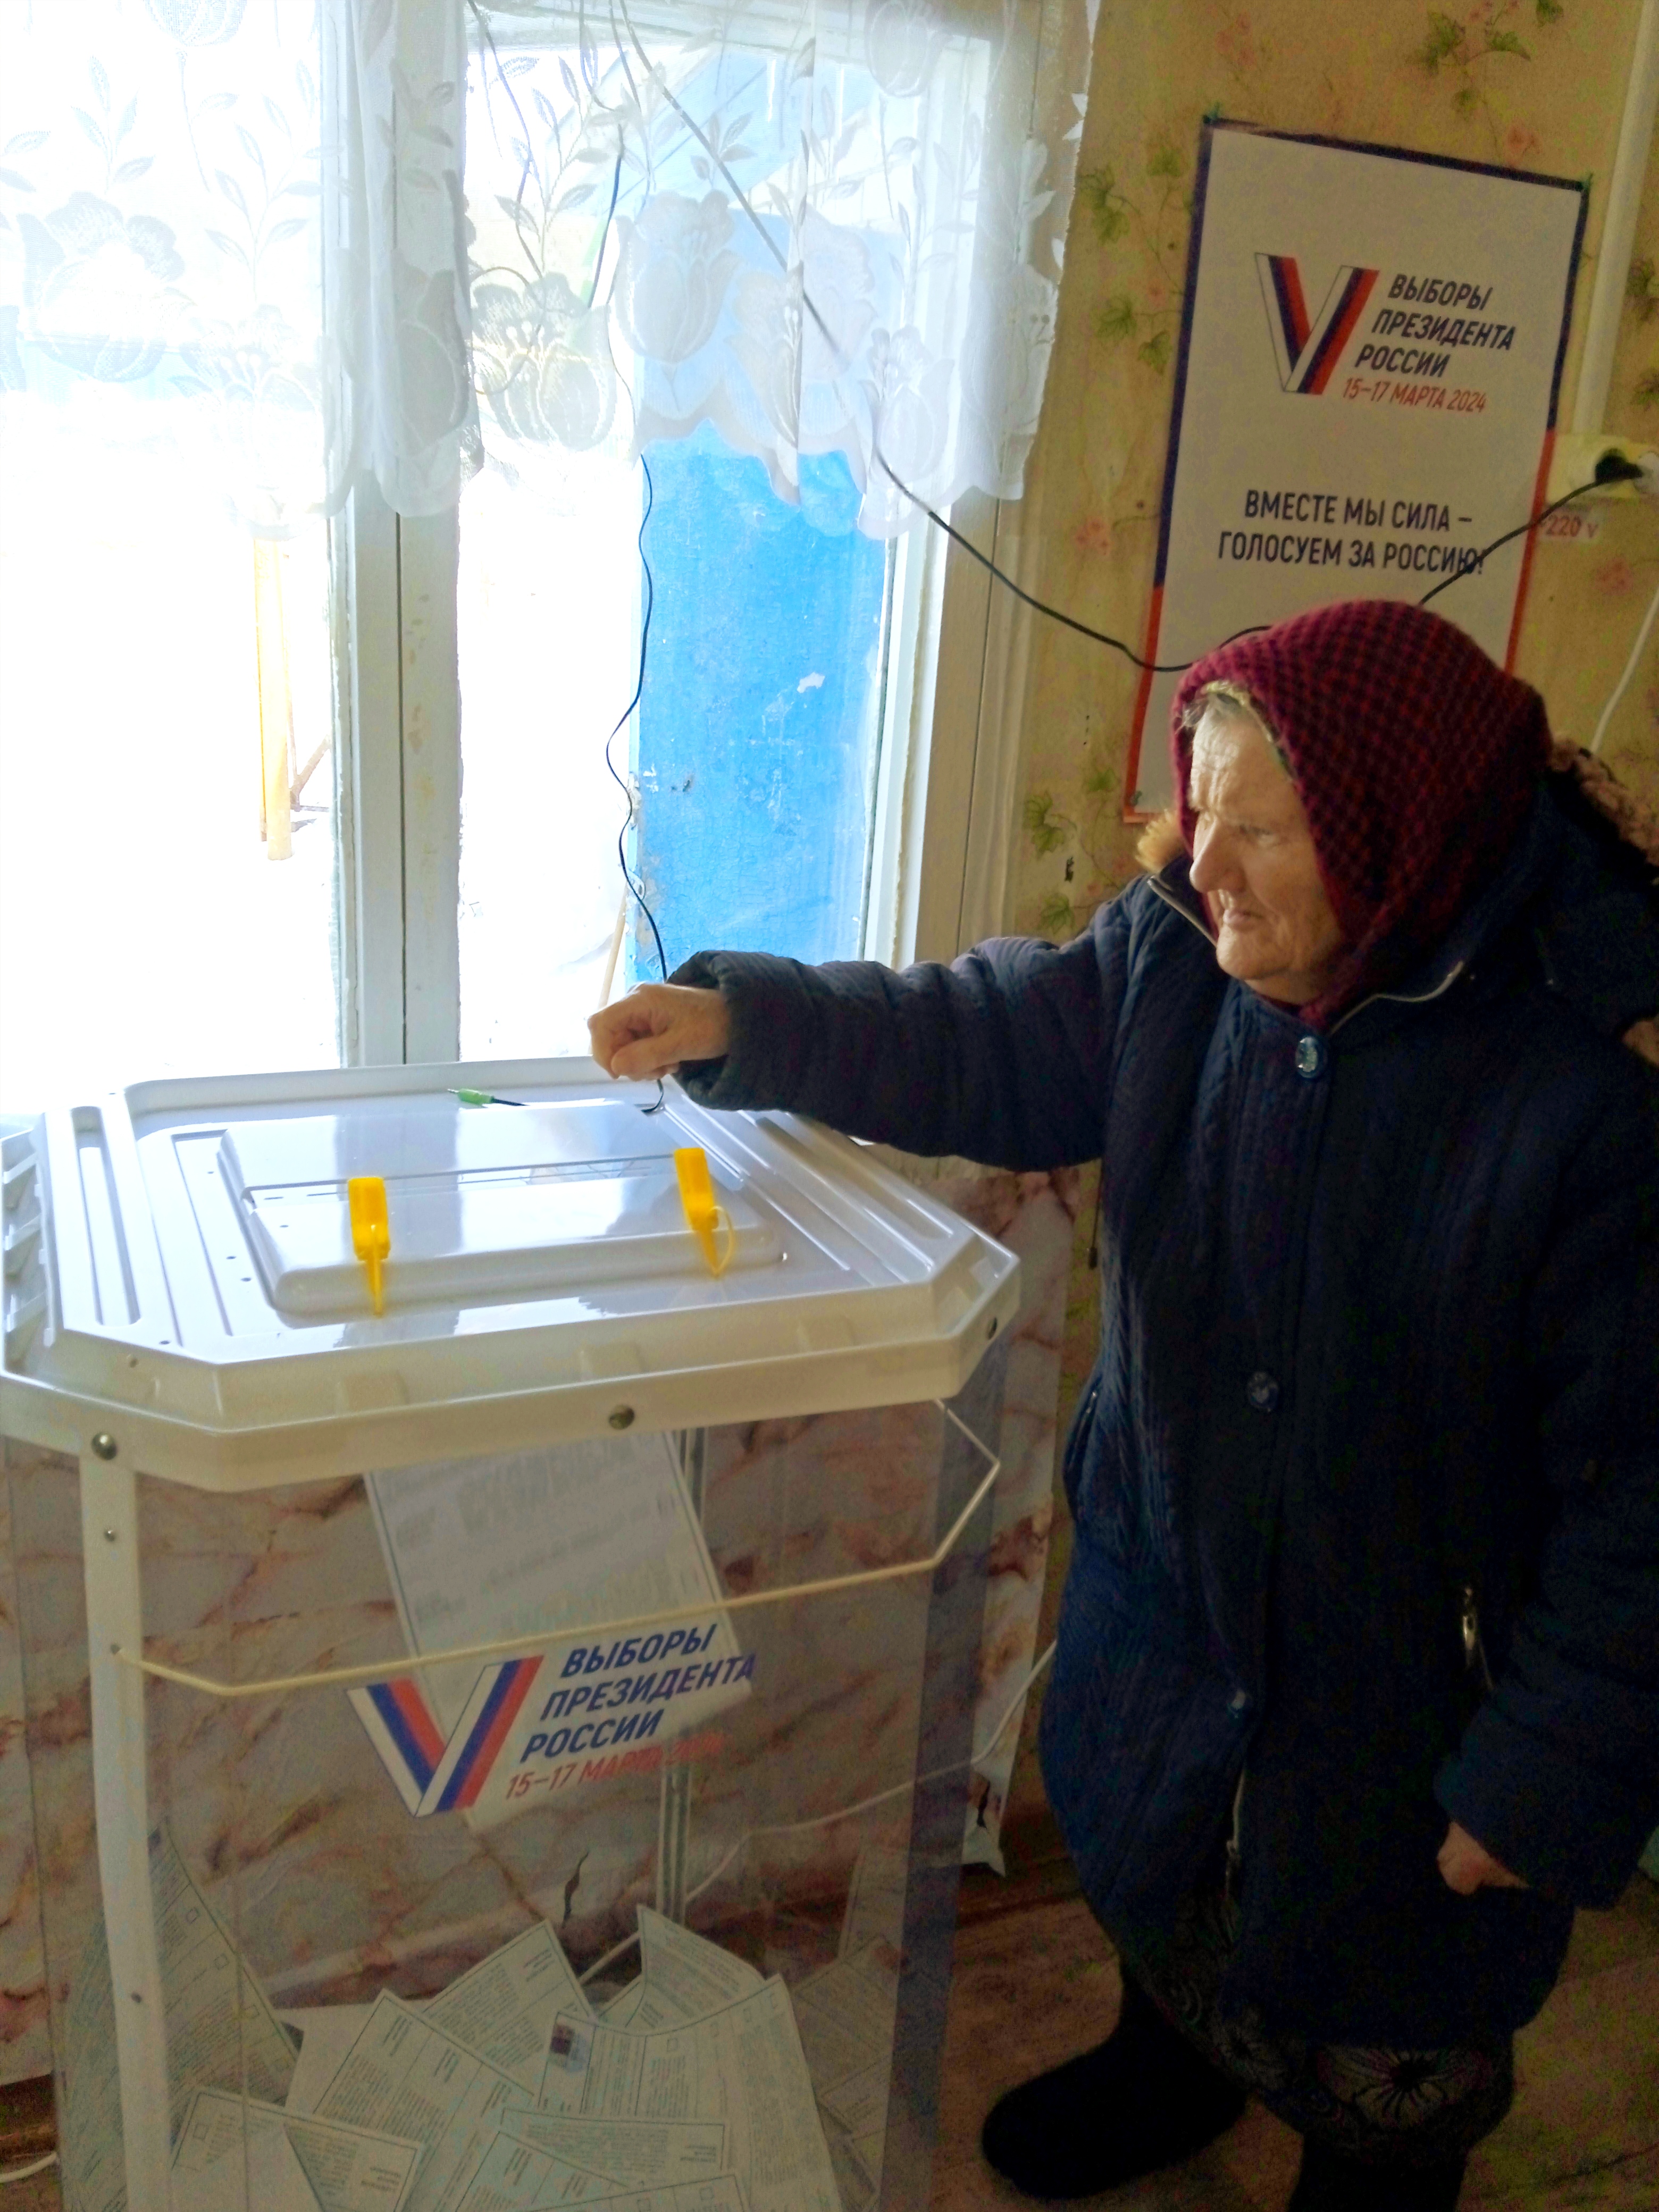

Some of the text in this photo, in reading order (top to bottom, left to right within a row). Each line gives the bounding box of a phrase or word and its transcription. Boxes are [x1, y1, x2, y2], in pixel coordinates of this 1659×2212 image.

[1387, 273, 1493, 311] ВЫБОРЫ
[1371, 308, 1515, 351] ПРЕЗИДЕНТА
[1354, 343, 1451, 378] РОССИИ
[1389, 382, 1448, 408] МАРТА
[1446, 389, 1487, 413] 2024
[1244, 489, 1338, 524] ВМЕСТЕ
[1343, 497, 1385, 527] МЫ
[1391, 501, 1450, 532] СИЛА
[1218, 531, 1487, 576] ГОЛОСУЕМ ЗА РОССИЮ!
[560, 1623, 717, 1679] ВЫБОРЫ
[540, 1652, 757, 1722] ПРЕЗИДЕНТА
[520, 1708, 665, 1764] РОССИИ
[578, 1743, 664, 1783] МАР
